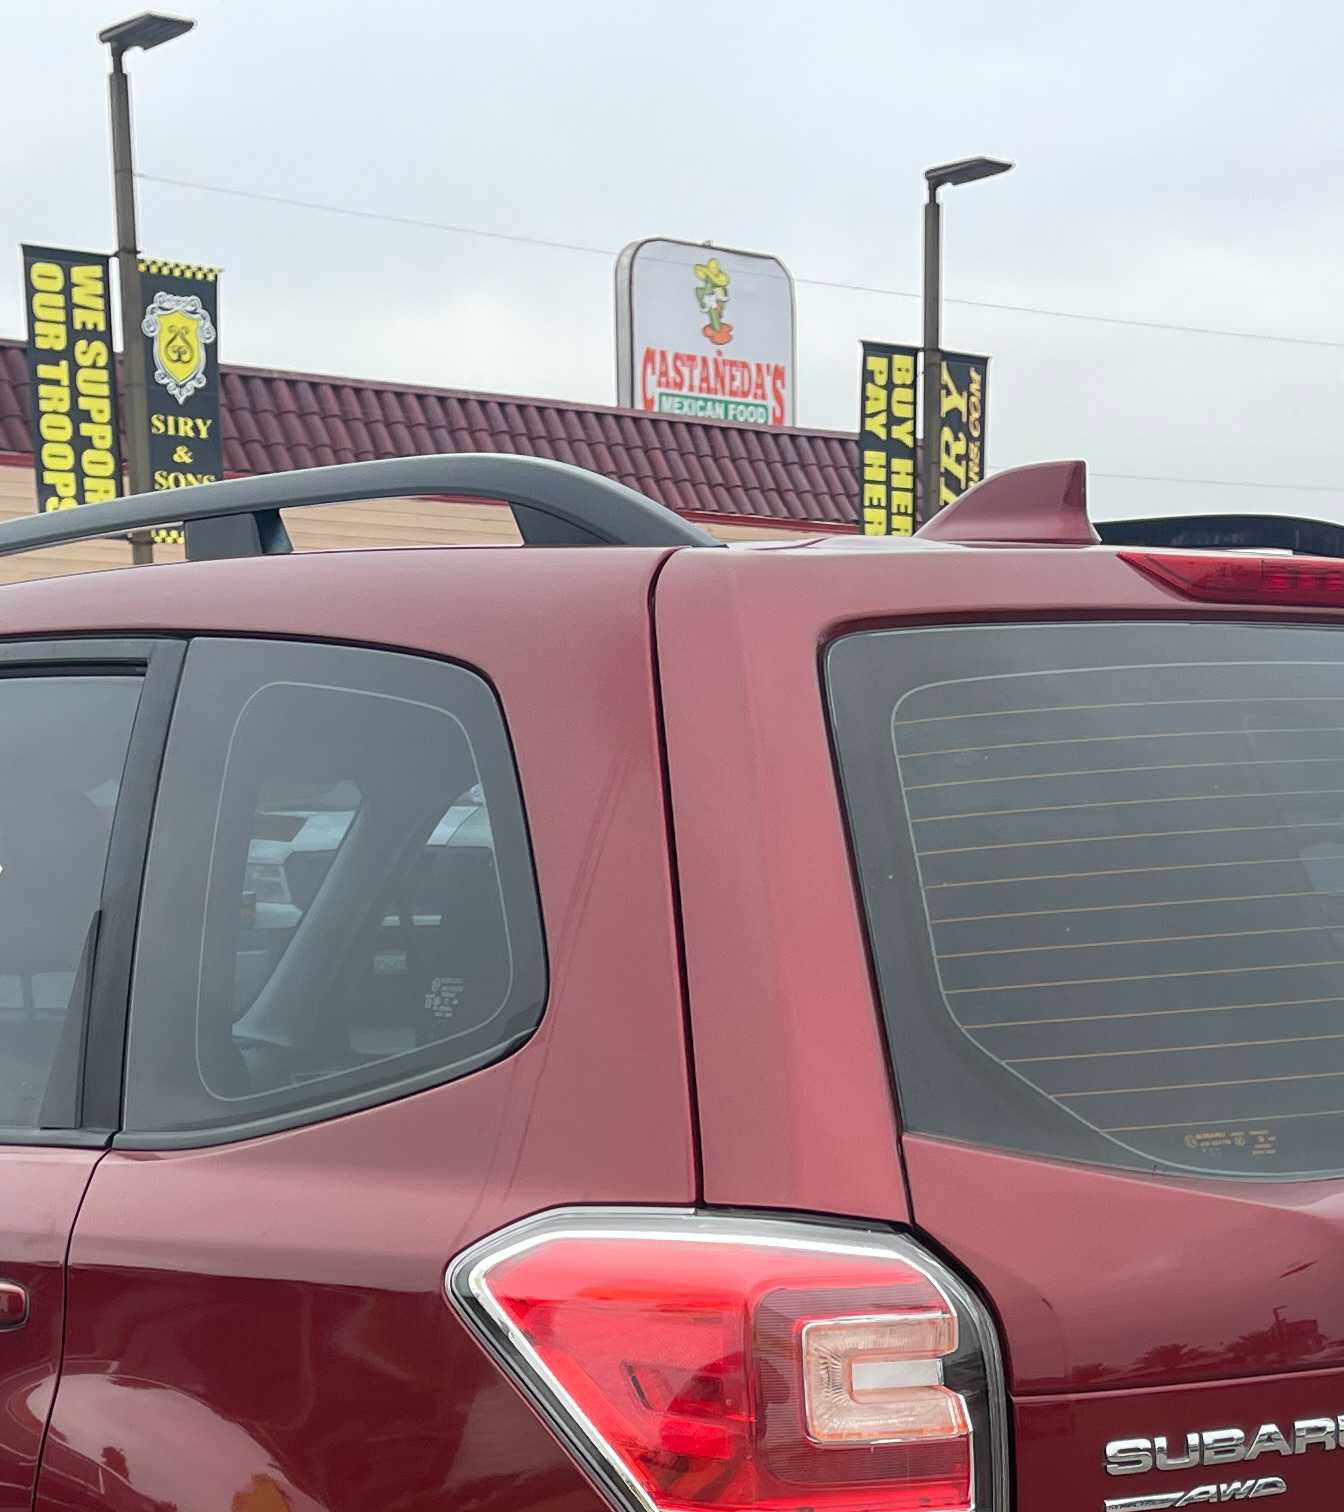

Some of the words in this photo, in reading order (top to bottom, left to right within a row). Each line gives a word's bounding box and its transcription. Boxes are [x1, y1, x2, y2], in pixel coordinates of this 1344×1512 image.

[30, 261, 68, 351] OUR
[70, 265, 106, 331] WE
[74, 339, 116, 503] SUPPOR
[151, 414, 212, 440] SIRY
[661, 396, 725, 420] MEXICAN
[729, 403, 769, 423] FOOD
[864, 356, 888, 441] PAY
[891, 354, 915, 448] BUY
[940, 361, 967, 506] IRY
[172, 446, 193, 464] &
[863, 451, 887, 536] HER
[891, 458, 914, 537] HER
[1175, 1476, 1288, 1507] AWD
